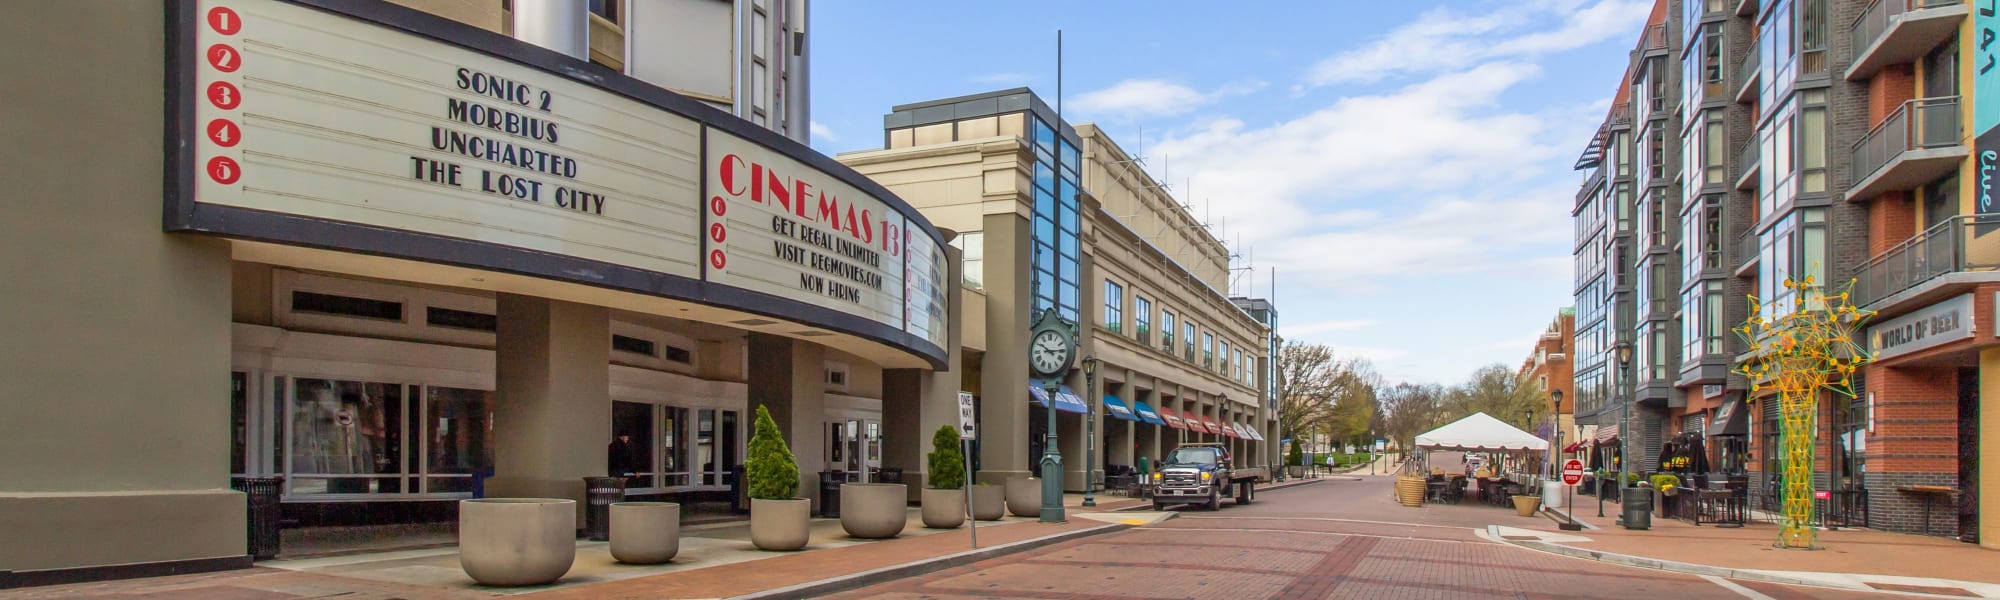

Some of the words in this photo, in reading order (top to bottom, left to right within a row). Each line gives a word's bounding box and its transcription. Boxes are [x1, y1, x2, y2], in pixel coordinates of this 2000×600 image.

[217, 12, 229, 31] 1
[217, 48, 232, 69] 2
[216, 86, 231, 106] 3
[456, 67, 530, 106] SONIC
[540, 90, 552, 112] 2
[215, 124, 231, 143] 4
[448, 97, 558, 144] MORBIUS
[216, 161, 232, 180] 5
[431, 126, 577, 179] UNCHARTED
[410, 155, 462, 187] THE
[482, 169, 543, 202] LOST
[555, 186, 606, 215] CITY
[1980, 149, 1998, 213] live
[719, 153, 873, 245] CINEMAS
[880, 220, 899, 257] 13
[772, 215, 796, 238] GET
[800, 224, 833, 251] REGAL
[836, 237, 880, 268] UNLIMITED
[774, 240, 806, 265] VISIT
[811, 252, 882, 291] REGMOVIES.COM
[800, 272, 824, 293] NOW
[828, 281, 860, 304] HIRING
[1881, 324, 1913, 350] WORLD
[1915, 318, 1928, 341] OF
[1930, 308, 1960, 337] BEER
[961, 394, 972, 406] ONE
